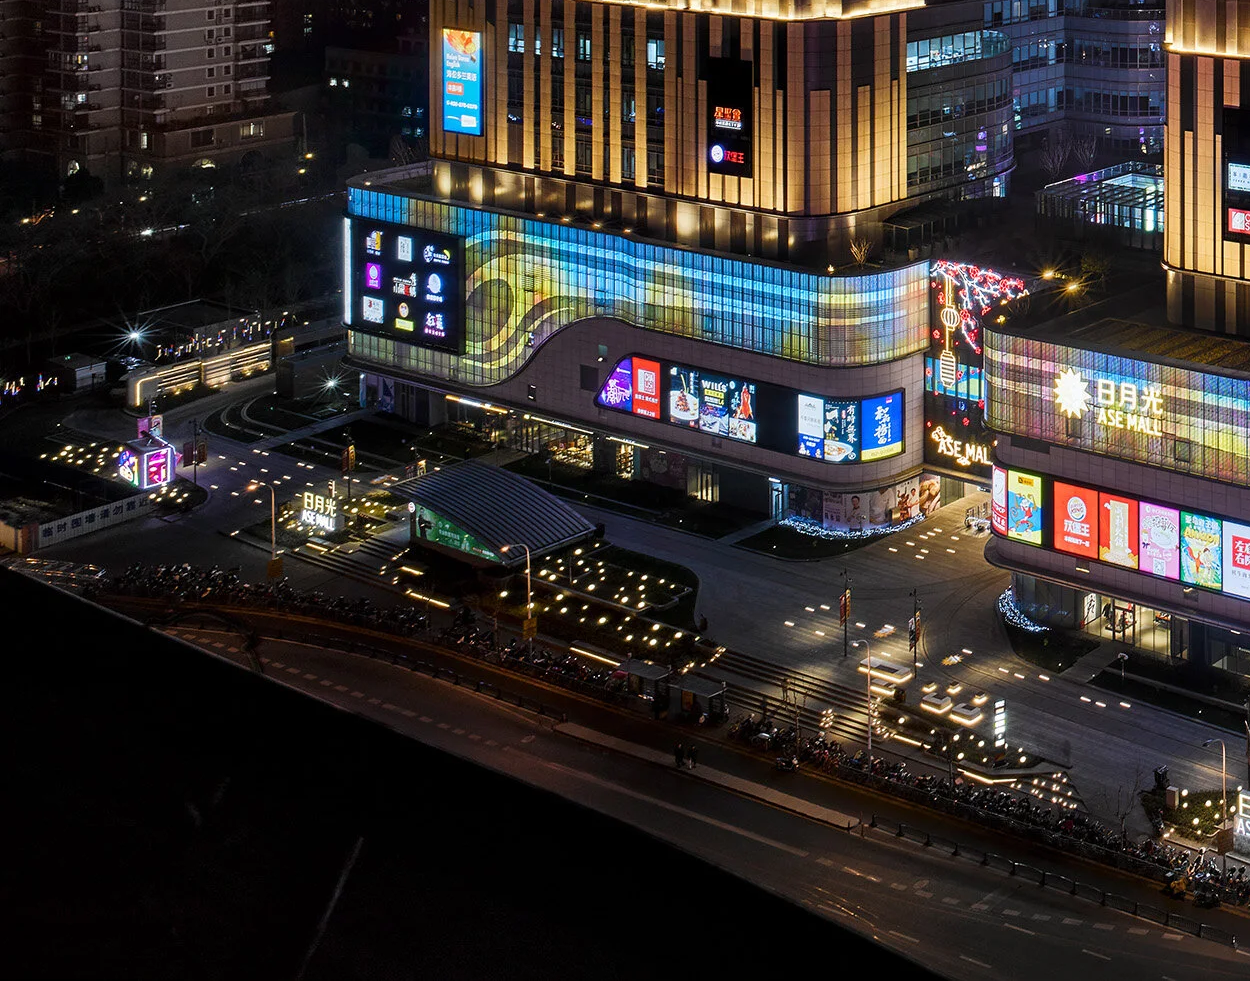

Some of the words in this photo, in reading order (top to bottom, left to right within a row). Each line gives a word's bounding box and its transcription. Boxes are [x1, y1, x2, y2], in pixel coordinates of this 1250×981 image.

[1098, 379, 1163, 414] 日月光
[1098, 410, 1123, 429] ASE
[1126, 413, 1163, 436] MALL
[938, 440, 961, 458] ASE
[965, 444, 994, 465] MAL
[304, 492, 337, 517] 日月光
[302, 510, 316, 525] ASE
[316, 515, 336, 531] MALL
[1064, 519, 1090, 537] 汉堡王
